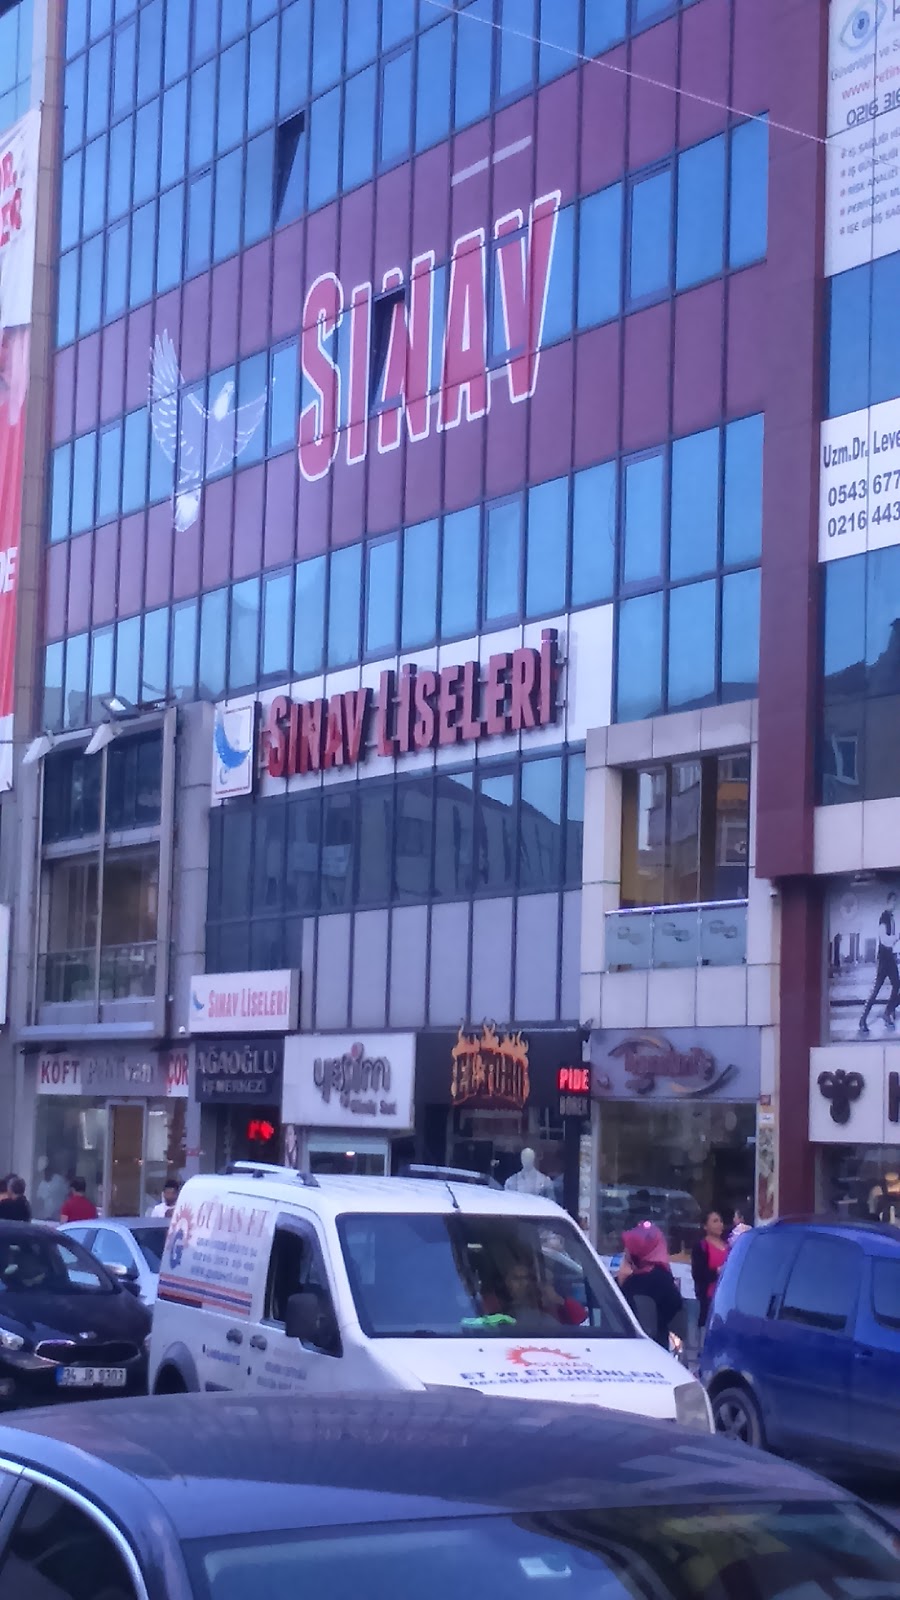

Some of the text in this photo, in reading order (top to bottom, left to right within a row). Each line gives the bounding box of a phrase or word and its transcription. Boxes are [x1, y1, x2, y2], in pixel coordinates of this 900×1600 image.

[846, 97, 878, 126] 0216
[298, 188, 561, 482] SINAV
[823, 436, 869, 468] Uzm.Dr.
[828, 468, 900, 507] 0543 677
[827, 500, 900, 537] 0216 443
[267, 628, 559, 777] SINAV LİSELERİ
[208, 989, 239, 1018] SINAV
